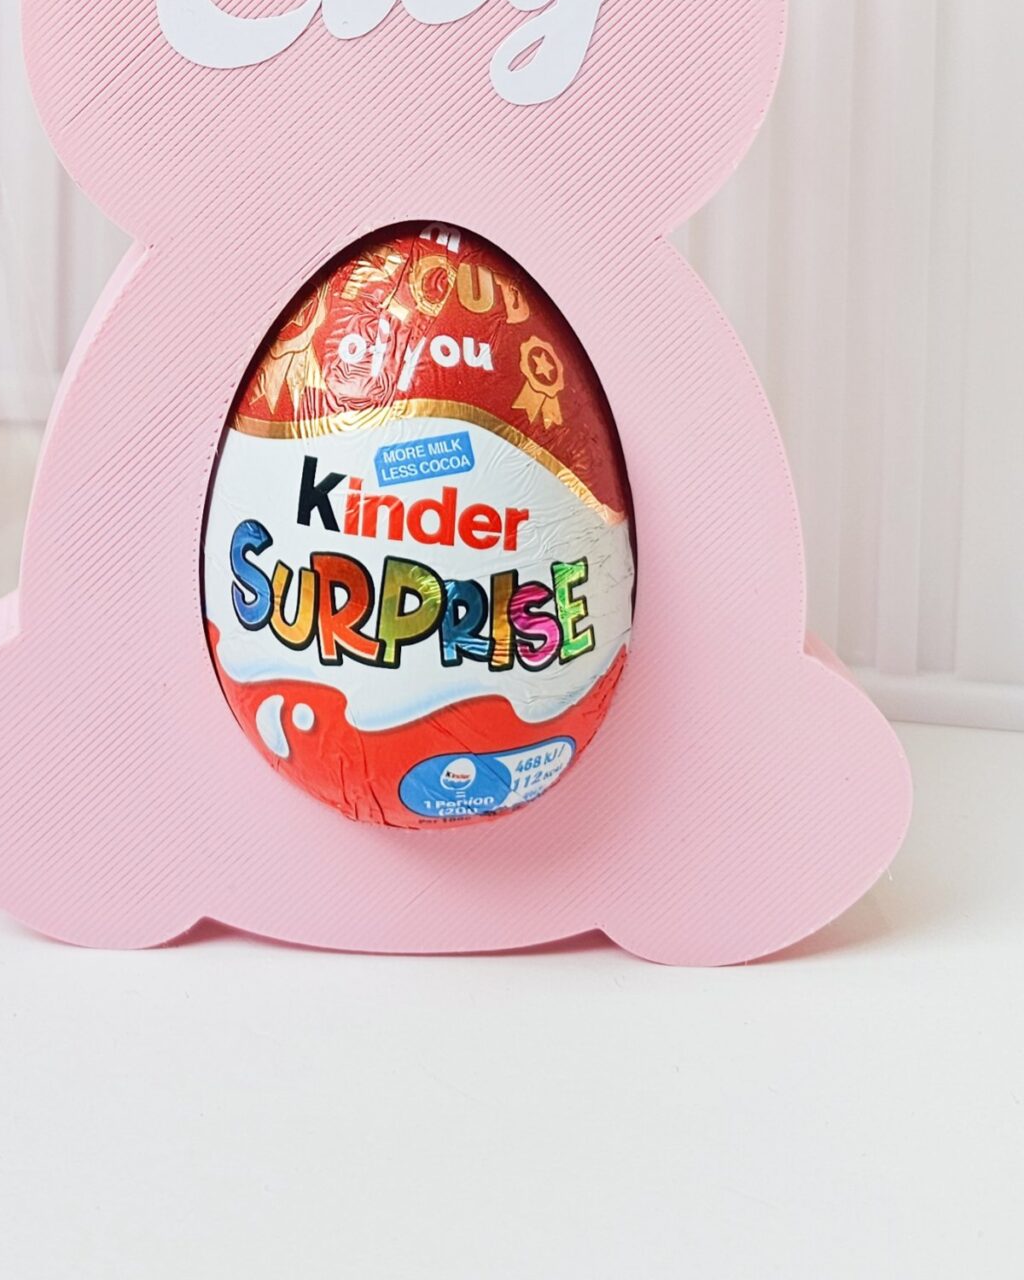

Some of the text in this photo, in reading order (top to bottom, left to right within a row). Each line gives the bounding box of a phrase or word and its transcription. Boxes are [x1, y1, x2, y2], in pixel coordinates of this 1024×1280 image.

[338, 318, 495, 393] of you
[383, 438, 462, 463] MORE MILK
[381, 455, 471, 481] LESS COCOA
[230, 518, 596, 672] SURPRISE
[515, 755, 542, 773] 468
[512, 770, 543, 792] 112
